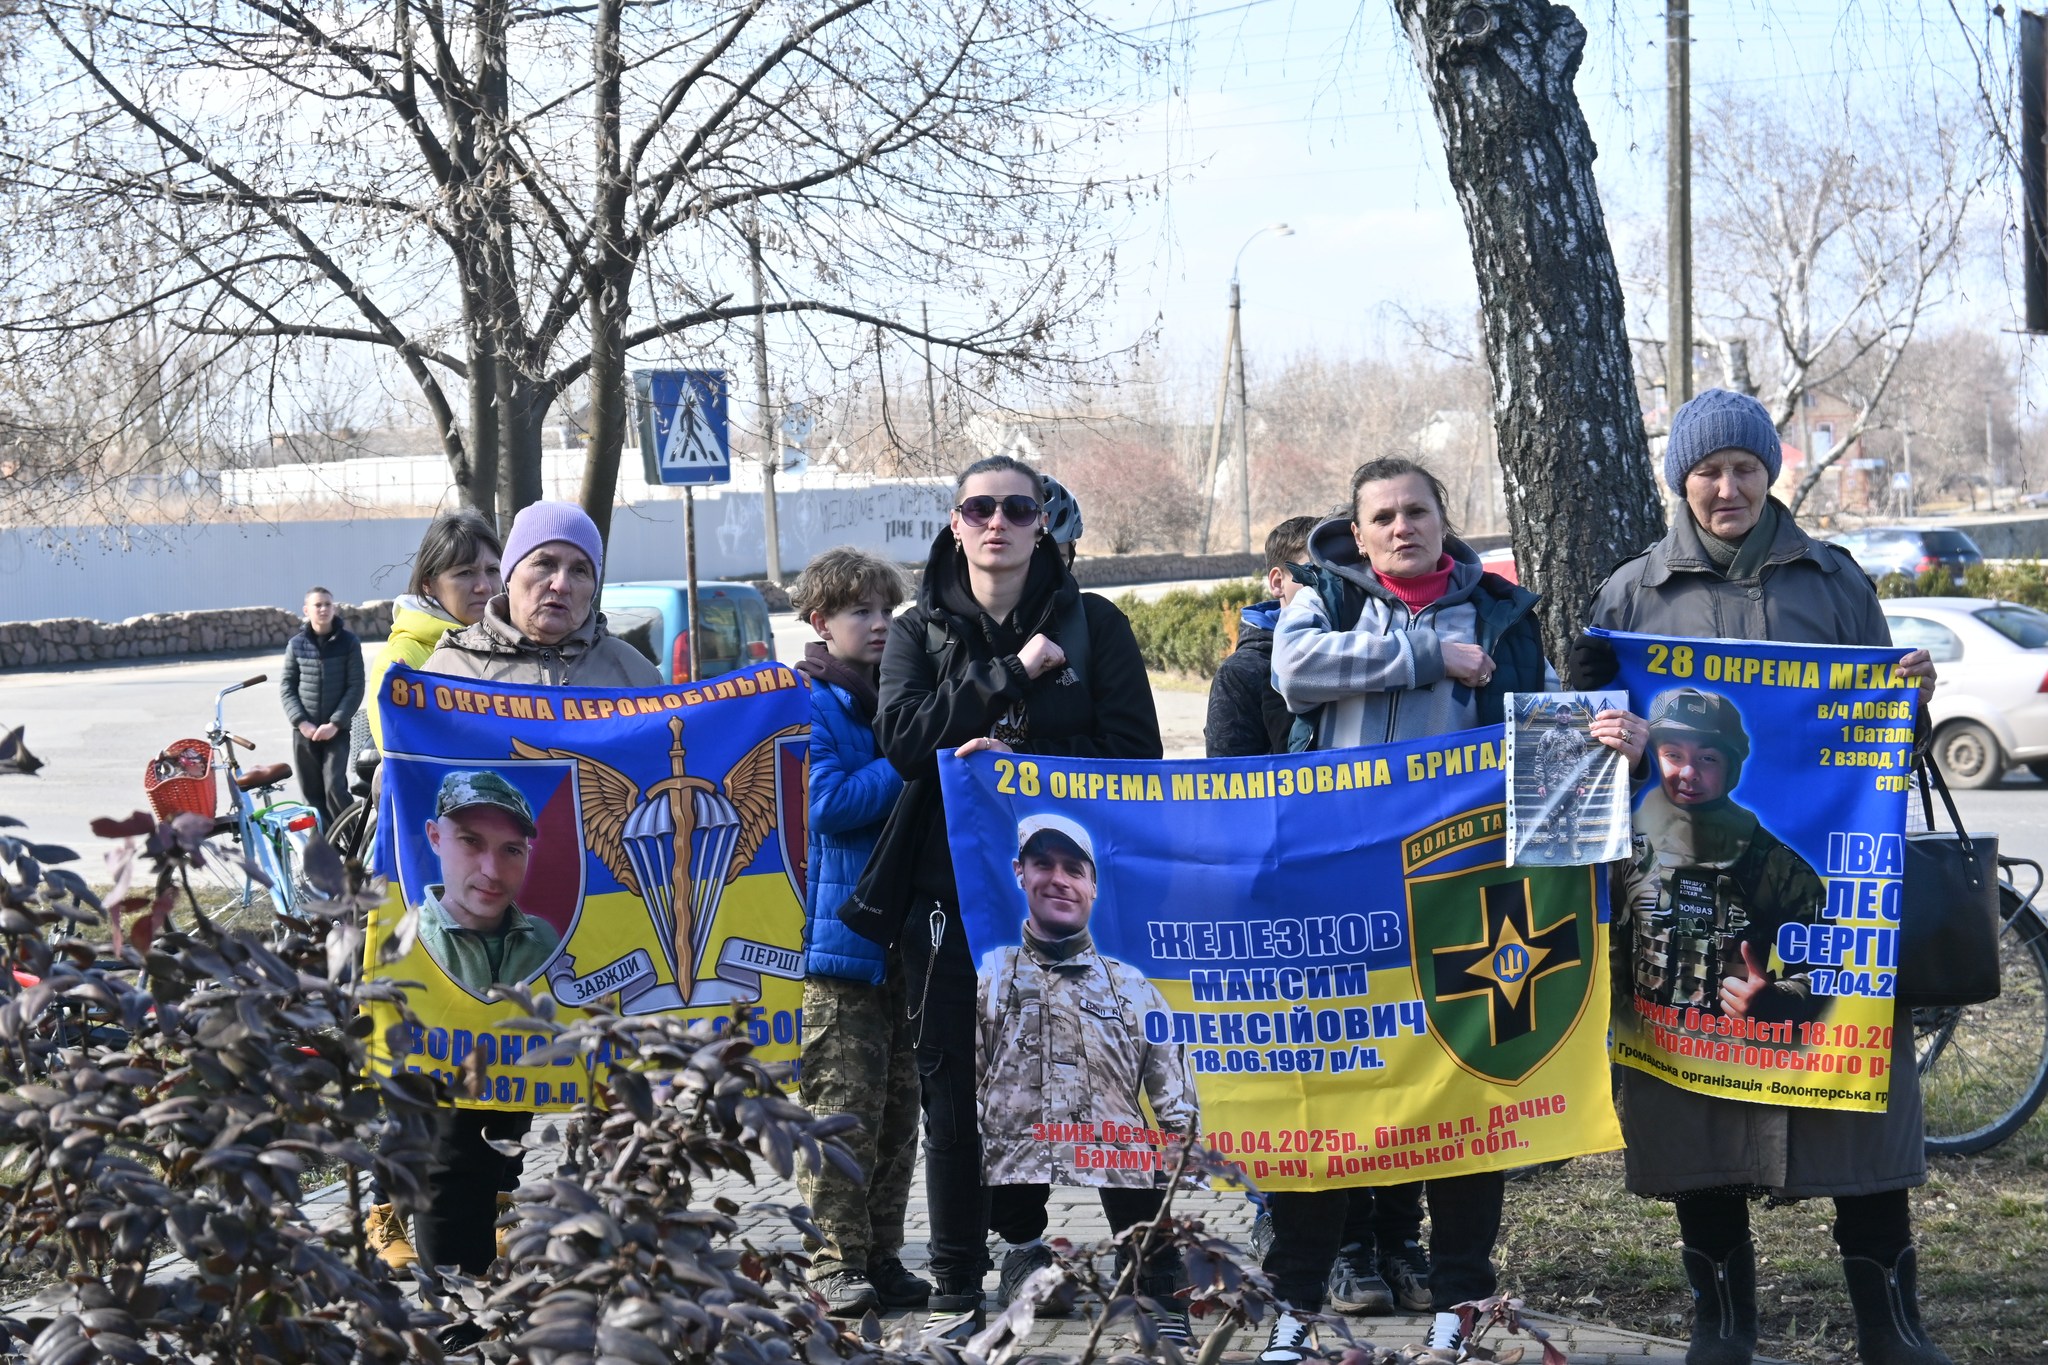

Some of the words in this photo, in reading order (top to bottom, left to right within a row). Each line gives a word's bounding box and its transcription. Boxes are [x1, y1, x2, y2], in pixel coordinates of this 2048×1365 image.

[1646, 643, 1695, 679] 28
[1703, 654, 1820, 689] ОКРЕМА
[390, 678, 427, 710] 81
[434, 686, 556, 721] ОКРЕМА
[563, 666, 797, 722] АЕРОМОБІЛЬНА
[1817, 702, 1849, 720] в/ч
[1841, 725, 1850, 743] 1
[1853, 725, 1914, 743] баталь
[994, 758, 1041, 798] 28
[1050, 770, 1164, 802] ОКРЕМА
[1172, 758, 1392, 801] МЕХАНІЗОВАНА
[1819, 748, 1831, 767] 2
[1835, 750, 1894, 770] взвод,
[1897, 749, 1906, 767] 1
[1411, 821, 1474, 860] ВОЛЕЮ
[1481, 813, 1503, 833] ТА
[1827, 831, 1904, 876] ІВА
[1147, 909, 1401, 961] ЖЕЛЕЗКОВ
[573, 954, 642, 1000] ЗАВЖДИ
[740, 944, 801, 973] ПЕРШІ
[1190, 962, 1369, 1004] МАКСИМ
[1808, 968, 1896, 998] 17.04.2
[1143, 998, 1427, 1046] ОЛЕКСІЙОВИЧ
[1633, 993, 1680, 1029] зник
[1684, 1006, 1793, 1045] безвісті
[1191, 1047, 1326, 1074] 18.06.1987
[1331, 1047, 1385, 1074] р/н.
[1618, 1043, 1679, 1077] Громадська
[1682, 1068, 1763, 1092] організація
[1767, 1081, 1872, 1101] «Волонтерська
[1654, 1025, 1863, 1075] Краматорського
[533, 1081, 586, 1107] р.н.
[1032, 1122, 1096, 1144] зник
[1374, 1122, 1432, 1151] біля
[1438, 1116, 1482, 1141] н.п.
[1488, 1092, 1568, 1131] Дачне
[1254, 1159, 1315, 1180] р-ну,
[1325, 1140, 1467, 1180] Донецької
[1471, 1129, 1531, 1166] обл.,
